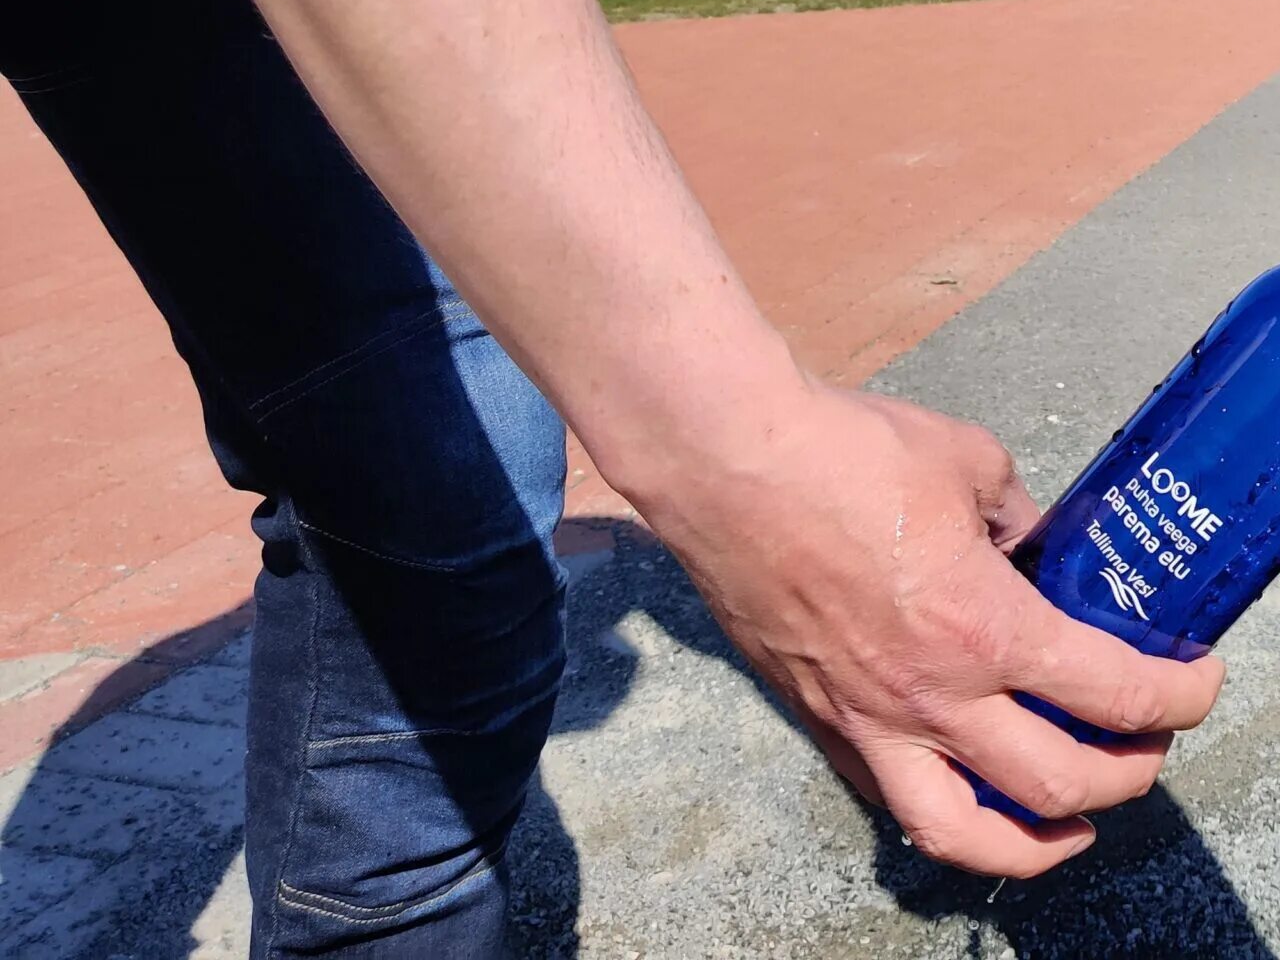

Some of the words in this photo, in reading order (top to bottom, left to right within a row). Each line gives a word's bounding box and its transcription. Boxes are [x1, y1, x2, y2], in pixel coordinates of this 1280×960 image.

[1102, 486, 1161, 554] parema
[1158, 550, 1191, 580] elu
[1125, 478, 1160, 518] puhta
[1158, 513, 1198, 555] veega
[1141, 452, 1224, 541] LOOME
[1086, 519, 1130, 575] Tallinna
[1127, 568, 1158, 598] Vesi
